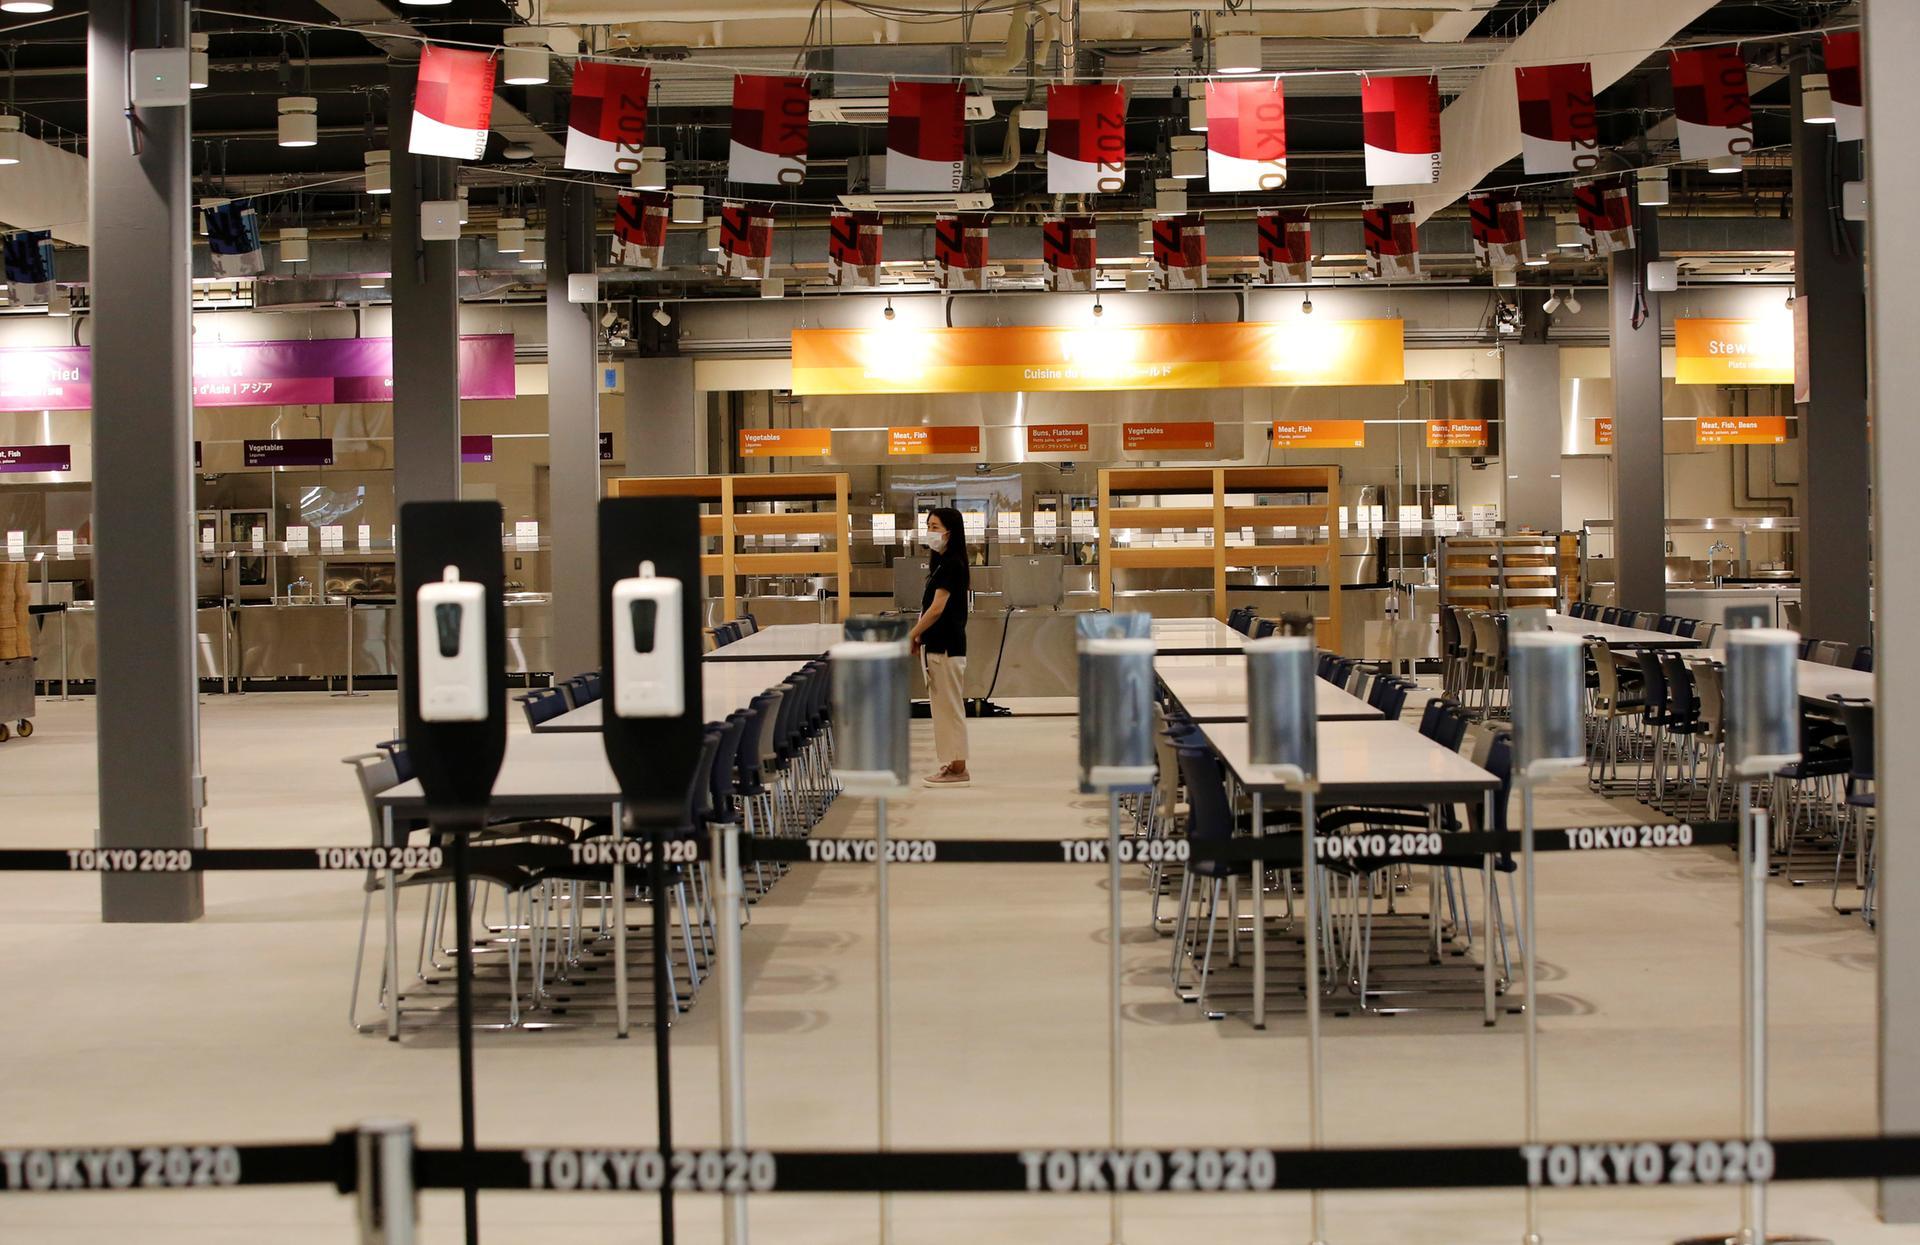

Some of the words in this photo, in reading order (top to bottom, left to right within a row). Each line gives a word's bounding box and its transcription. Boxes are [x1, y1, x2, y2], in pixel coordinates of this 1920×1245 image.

[614, 92, 648, 175] 2020
[778, 81, 810, 186] TOKYO
[1567, 91, 1600, 173] 2020
[1096, 112, 1126, 193] 2020
[1023, 367, 1061, 379] Cuisine
[240, 382, 273, 395] アジア
[893, 431, 912, 440] Meat,
[913, 431, 928, 439] Fish
[1032, 429, 1051, 437] Buns,
[1052, 428, 1084, 436] Flatbread
[1127, 427, 1164, 436] Vegetables
[1277, 425, 1297, 434] Meat,
[1298, 425, 1313, 433] Fish
[1431, 424, 1450, 432] Buns,
[1451, 424, 1483, 432] Flatbread
[1701, 421, 1720, 430] Meat,
[1721, 421, 1737, 430] Fish,
[1738, 421, 1758, 429] Beans
[248, 444, 284, 453] Vegetables
[744, 433, 781, 442] Vegetables
[8, 450, 22, 458] Fish
[1313, 835, 1384, 858] TOKYO
[1388, 833, 1442, 856] 2020
[1565, 826, 1637, 849] TOKYO
[1639, 824, 1693, 847] 2020
[67, 850, 137, 872] TOKYO
[139, 849, 192, 872] 2020
[316, 848, 386, 870] TOKYO
[389, 847, 442, 869] 2020
[569, 842, 641, 865] TOKYO
[807, 840, 878, 862] TOKYO
[885, 840, 936, 862] 2020
[1060, 840, 1133, 862] TOKO
[1136, 839, 1190, 861] 2020
[0, 1151, 135, 1191] TOKYO
[138, 1147, 241, 1188] 2020
[522, 1151, 665, 1191] TOKYO
[671, 1151, 776, 1192] 2020
[1018, 1151, 1163, 1192] TOKYO
[1169, 1150, 1277, 1191] 2020
[1521, 1146, 1664, 1186] TOKYO
[1670, 1141, 1776, 1183] 2020
